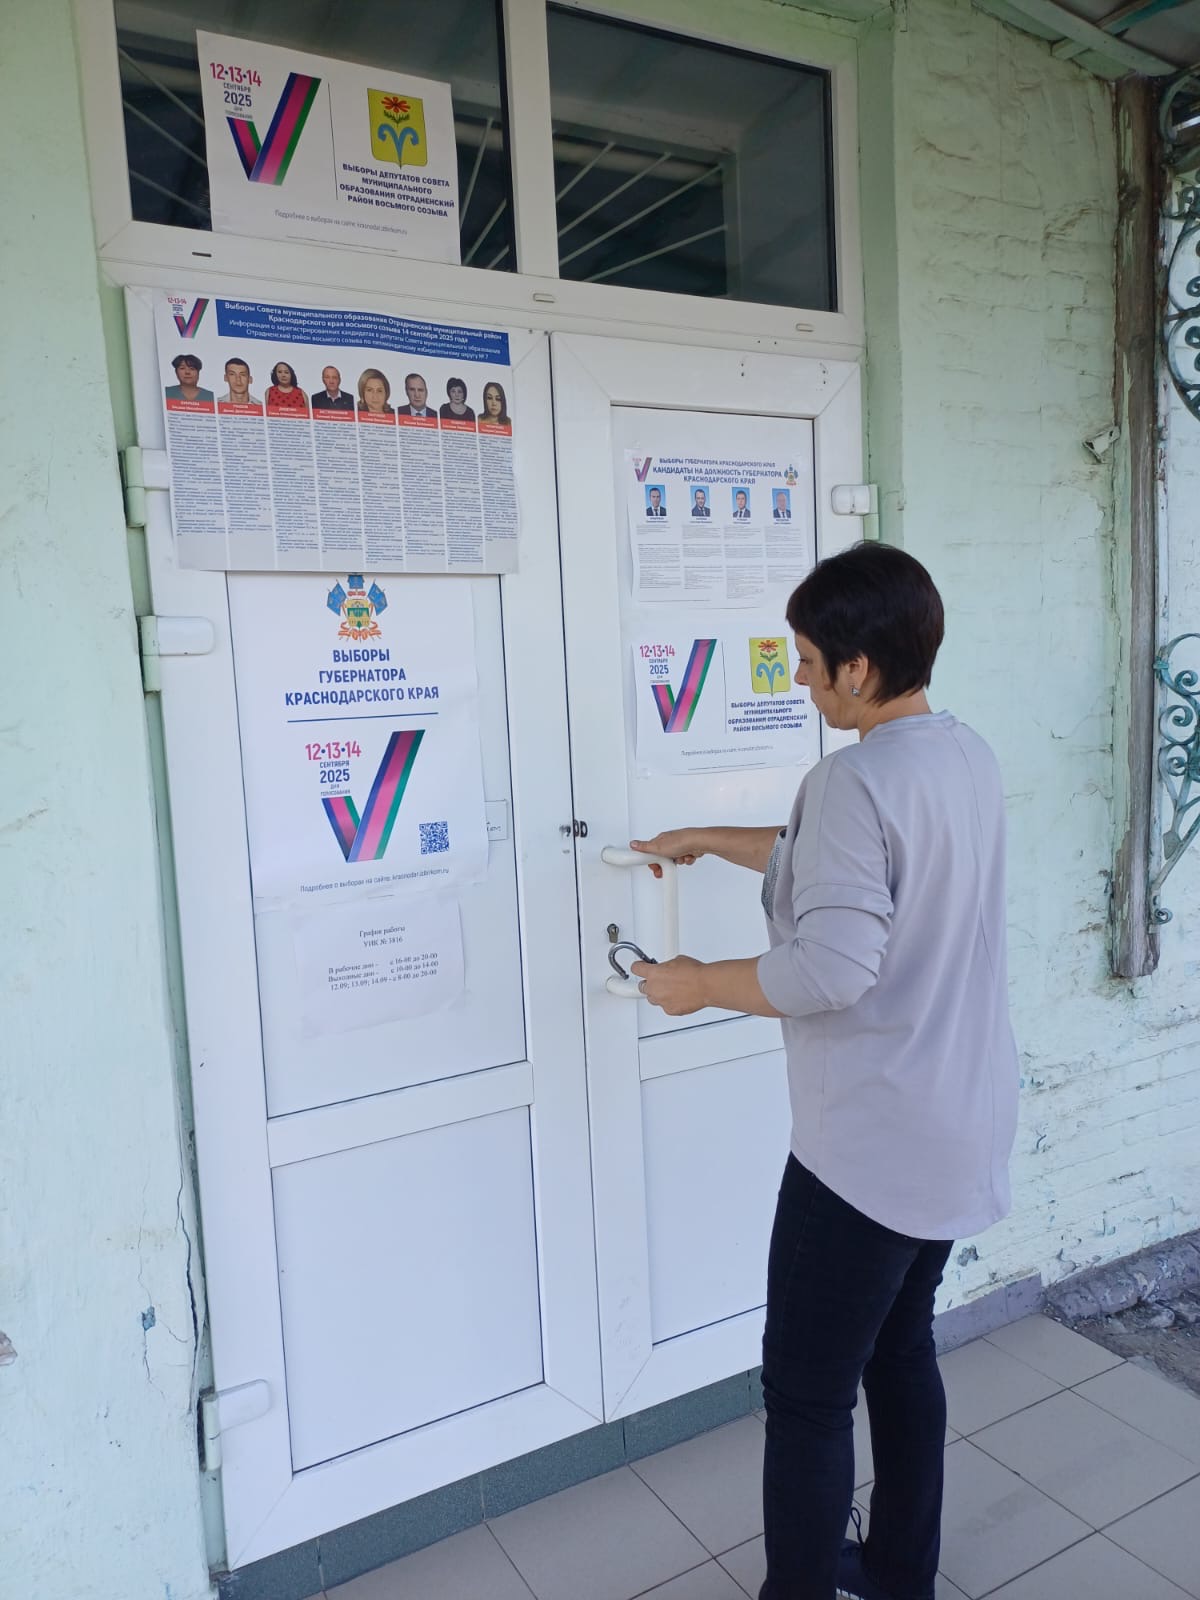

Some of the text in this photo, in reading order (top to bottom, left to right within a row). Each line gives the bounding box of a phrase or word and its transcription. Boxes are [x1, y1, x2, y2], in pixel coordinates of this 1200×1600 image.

[224, 90, 252, 107] 2025
[342, 163, 450, 187] ВЫБОРЫ ДЕПУТАТОВ СОВЕТА
[362, 177, 432, 195] МУНИЦИПАЛЬНОГО
[340, 184, 454, 208] ОБРАЗОВАНИЯ ОТРАДНЕНСКИЙ
[348, 194, 448, 217] РАЙОН ВОСЬМОГО СОЗЫВА
[225, 302, 256, 312] Выборы
[256, 306, 282, 314] Совета
[282, 310, 343, 320] муниципального
[344, 313, 387, 323] образования
[269, 314, 326, 327] Краснодарского
[346, 322, 378, 330] восьмого
[410, 330, 438, 340] сентября
[653, 466, 694, 474] КАНДИДАТЫ
[742, 470, 782, 478] ГУБЕРНАТОРА
[684, 476, 739, 484] КРАСНОДАРСКОГО
[333, 648, 390, 663] ВЫБОРЫ
[319, 668, 406, 684] ГУБЕРНАТОРА
[650, 665, 669, 674] 2025
[285, 686, 439, 706] КРАСНОДАРСКОГО КРАЯ
[320, 760, 350, 769] СЕНТЯБРЯ
[320, 769, 350, 784] 2025
[300, 883, 333, 892] Подробнее
[340, 880, 364, 888] выборах
[360, 926, 405, 938] График работы
[335, 964, 360, 975] рабочие
[422, 960, 439, 968] 14-00
[331, 982, 350, 991] 12.09;
